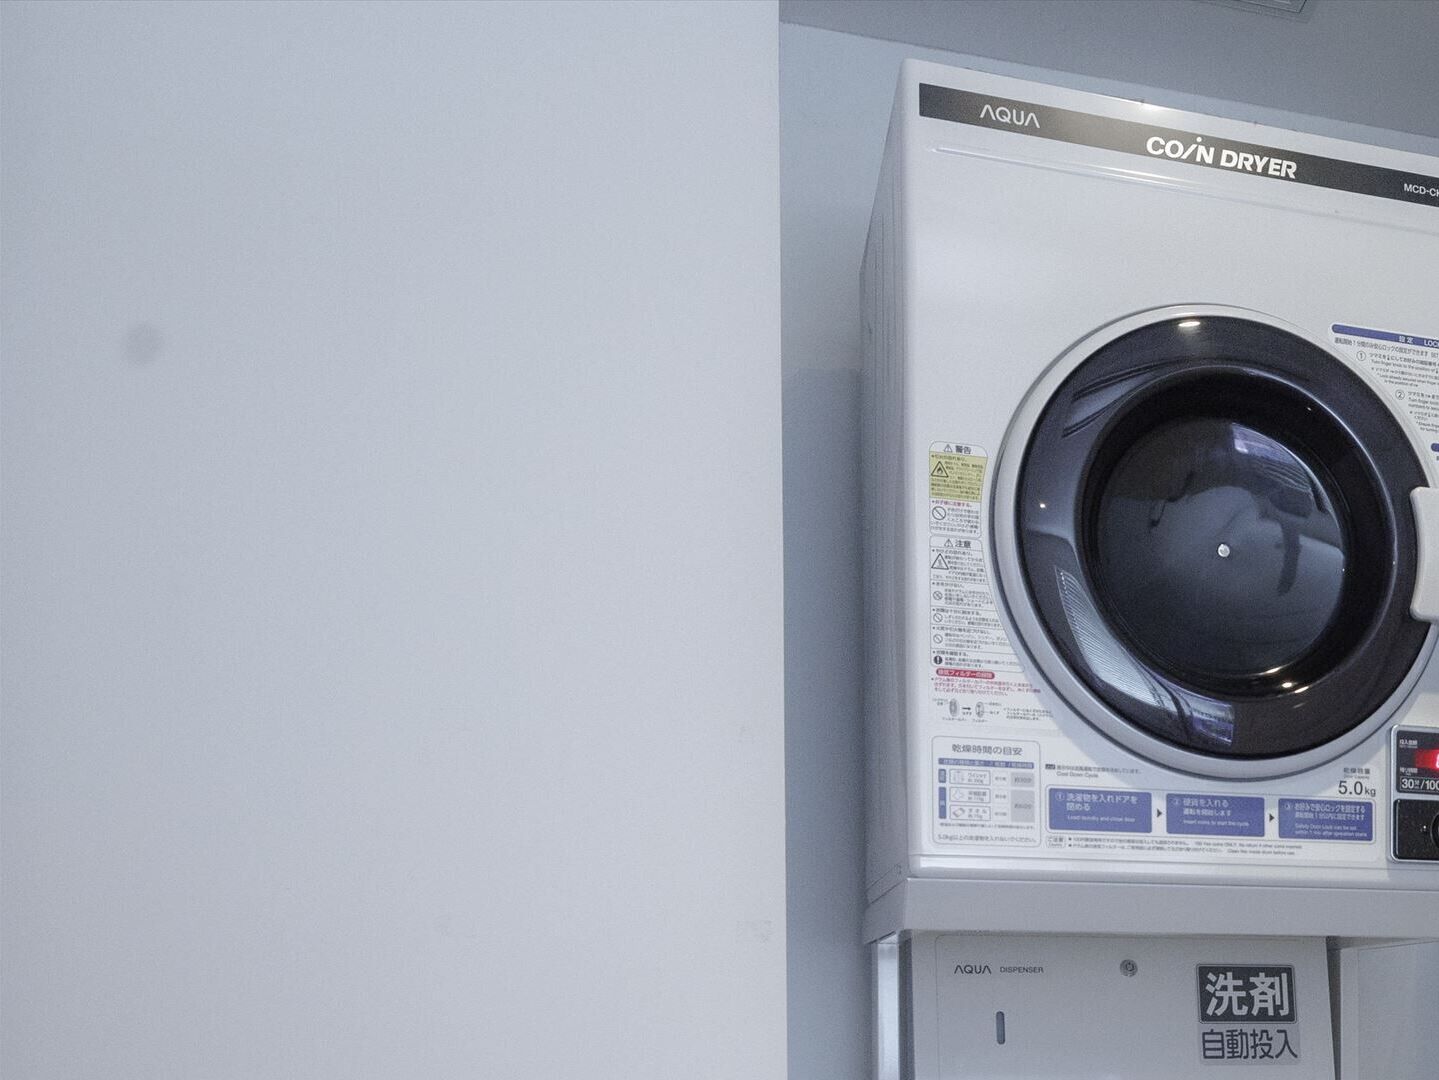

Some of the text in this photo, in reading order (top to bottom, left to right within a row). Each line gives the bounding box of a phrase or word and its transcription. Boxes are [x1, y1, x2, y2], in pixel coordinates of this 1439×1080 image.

[979, 104, 1041, 129] AQUA
[1146, 136, 1298, 180] COIN DRYER
[951, 743, 1024, 756] 乾燥時間の目安
[1338, 781, 1377, 798] 5.0kg
[954, 964, 1044, 975] AQUA DISPENSER
[1206, 970, 1289, 1017] 洗剤
[1201, 1028, 1299, 1061] 自動投入
